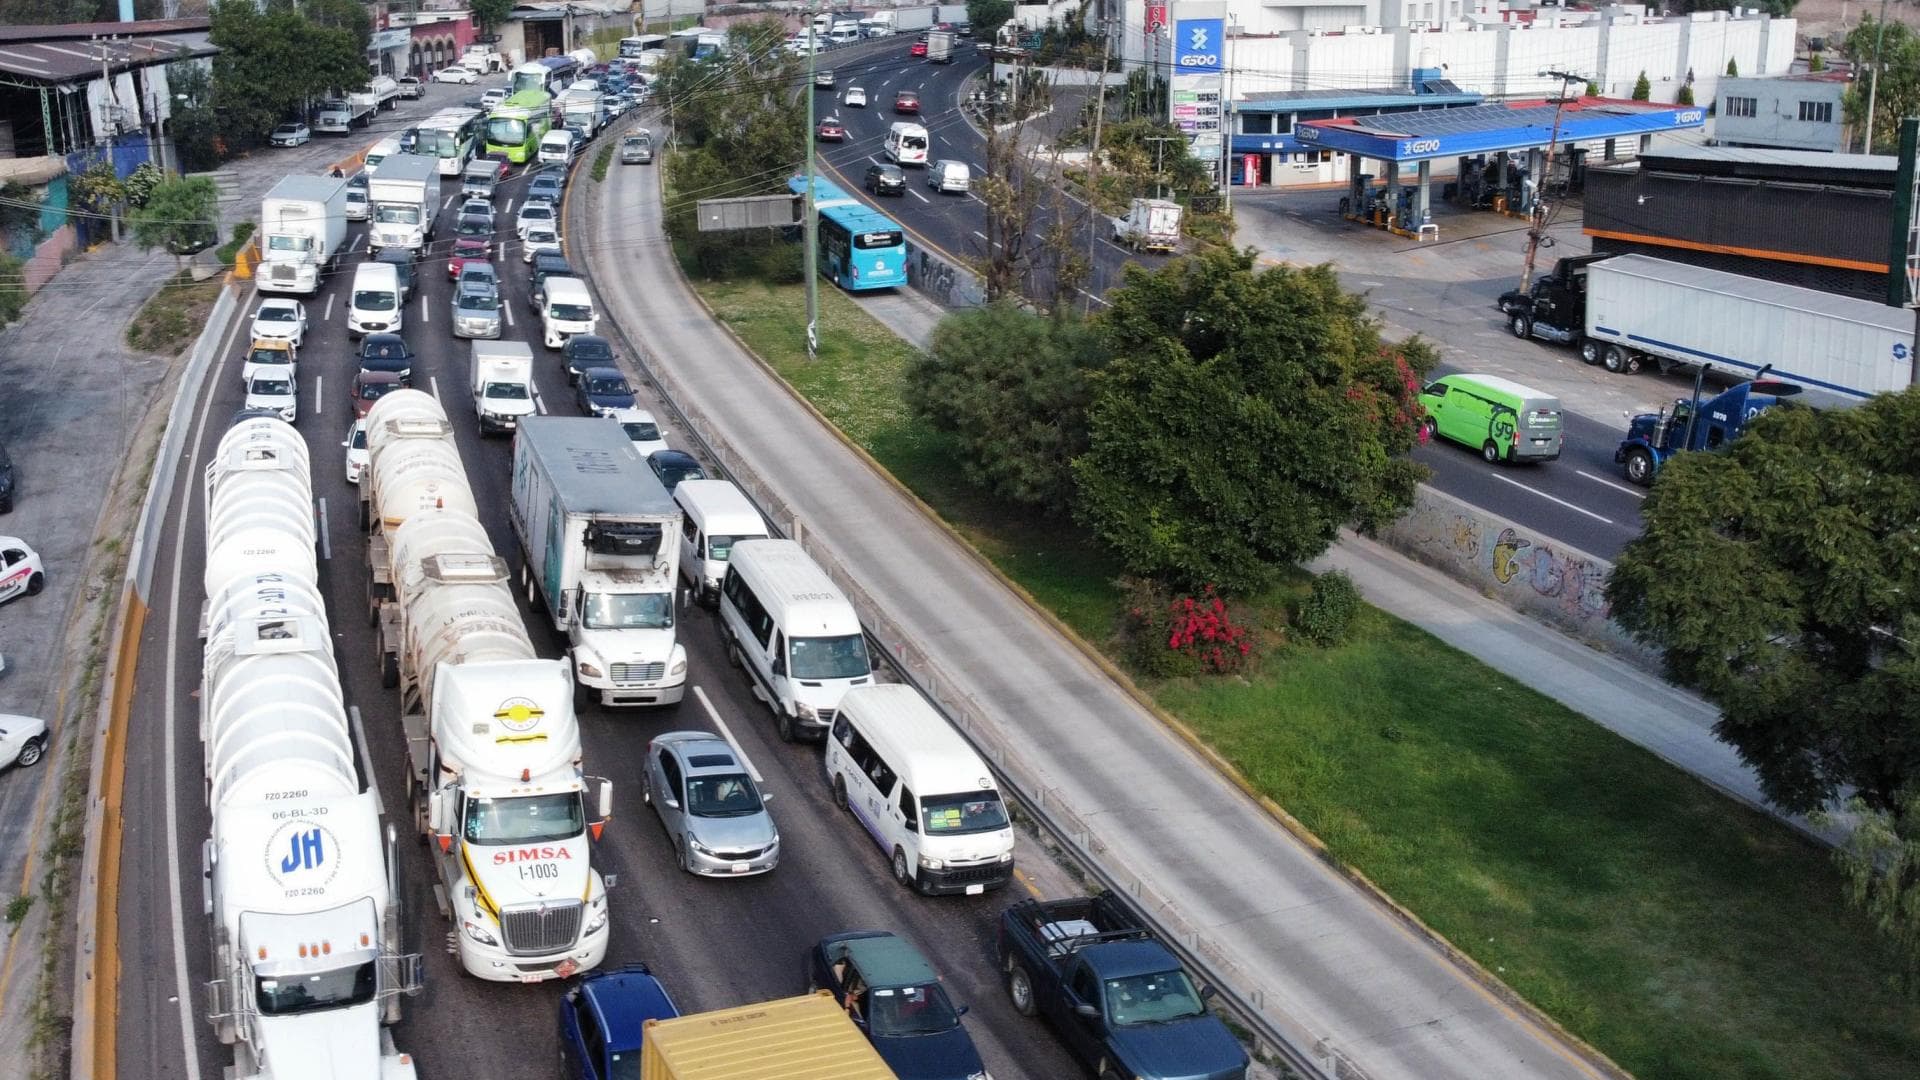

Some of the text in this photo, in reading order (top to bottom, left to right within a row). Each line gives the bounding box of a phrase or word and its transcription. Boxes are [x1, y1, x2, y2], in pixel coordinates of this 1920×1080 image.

[1180, 54, 1217, 66] G500
[1412, 139, 1441, 154] G500
[282, 789, 309, 800] 2260
[272, 806, 329, 820] 06-BL-3D
[281, 828, 324, 874] JH
[493, 847, 572, 866] SIMSA
[518, 863, 559, 880] I-1003
[300, 887, 325, 896] 2260
